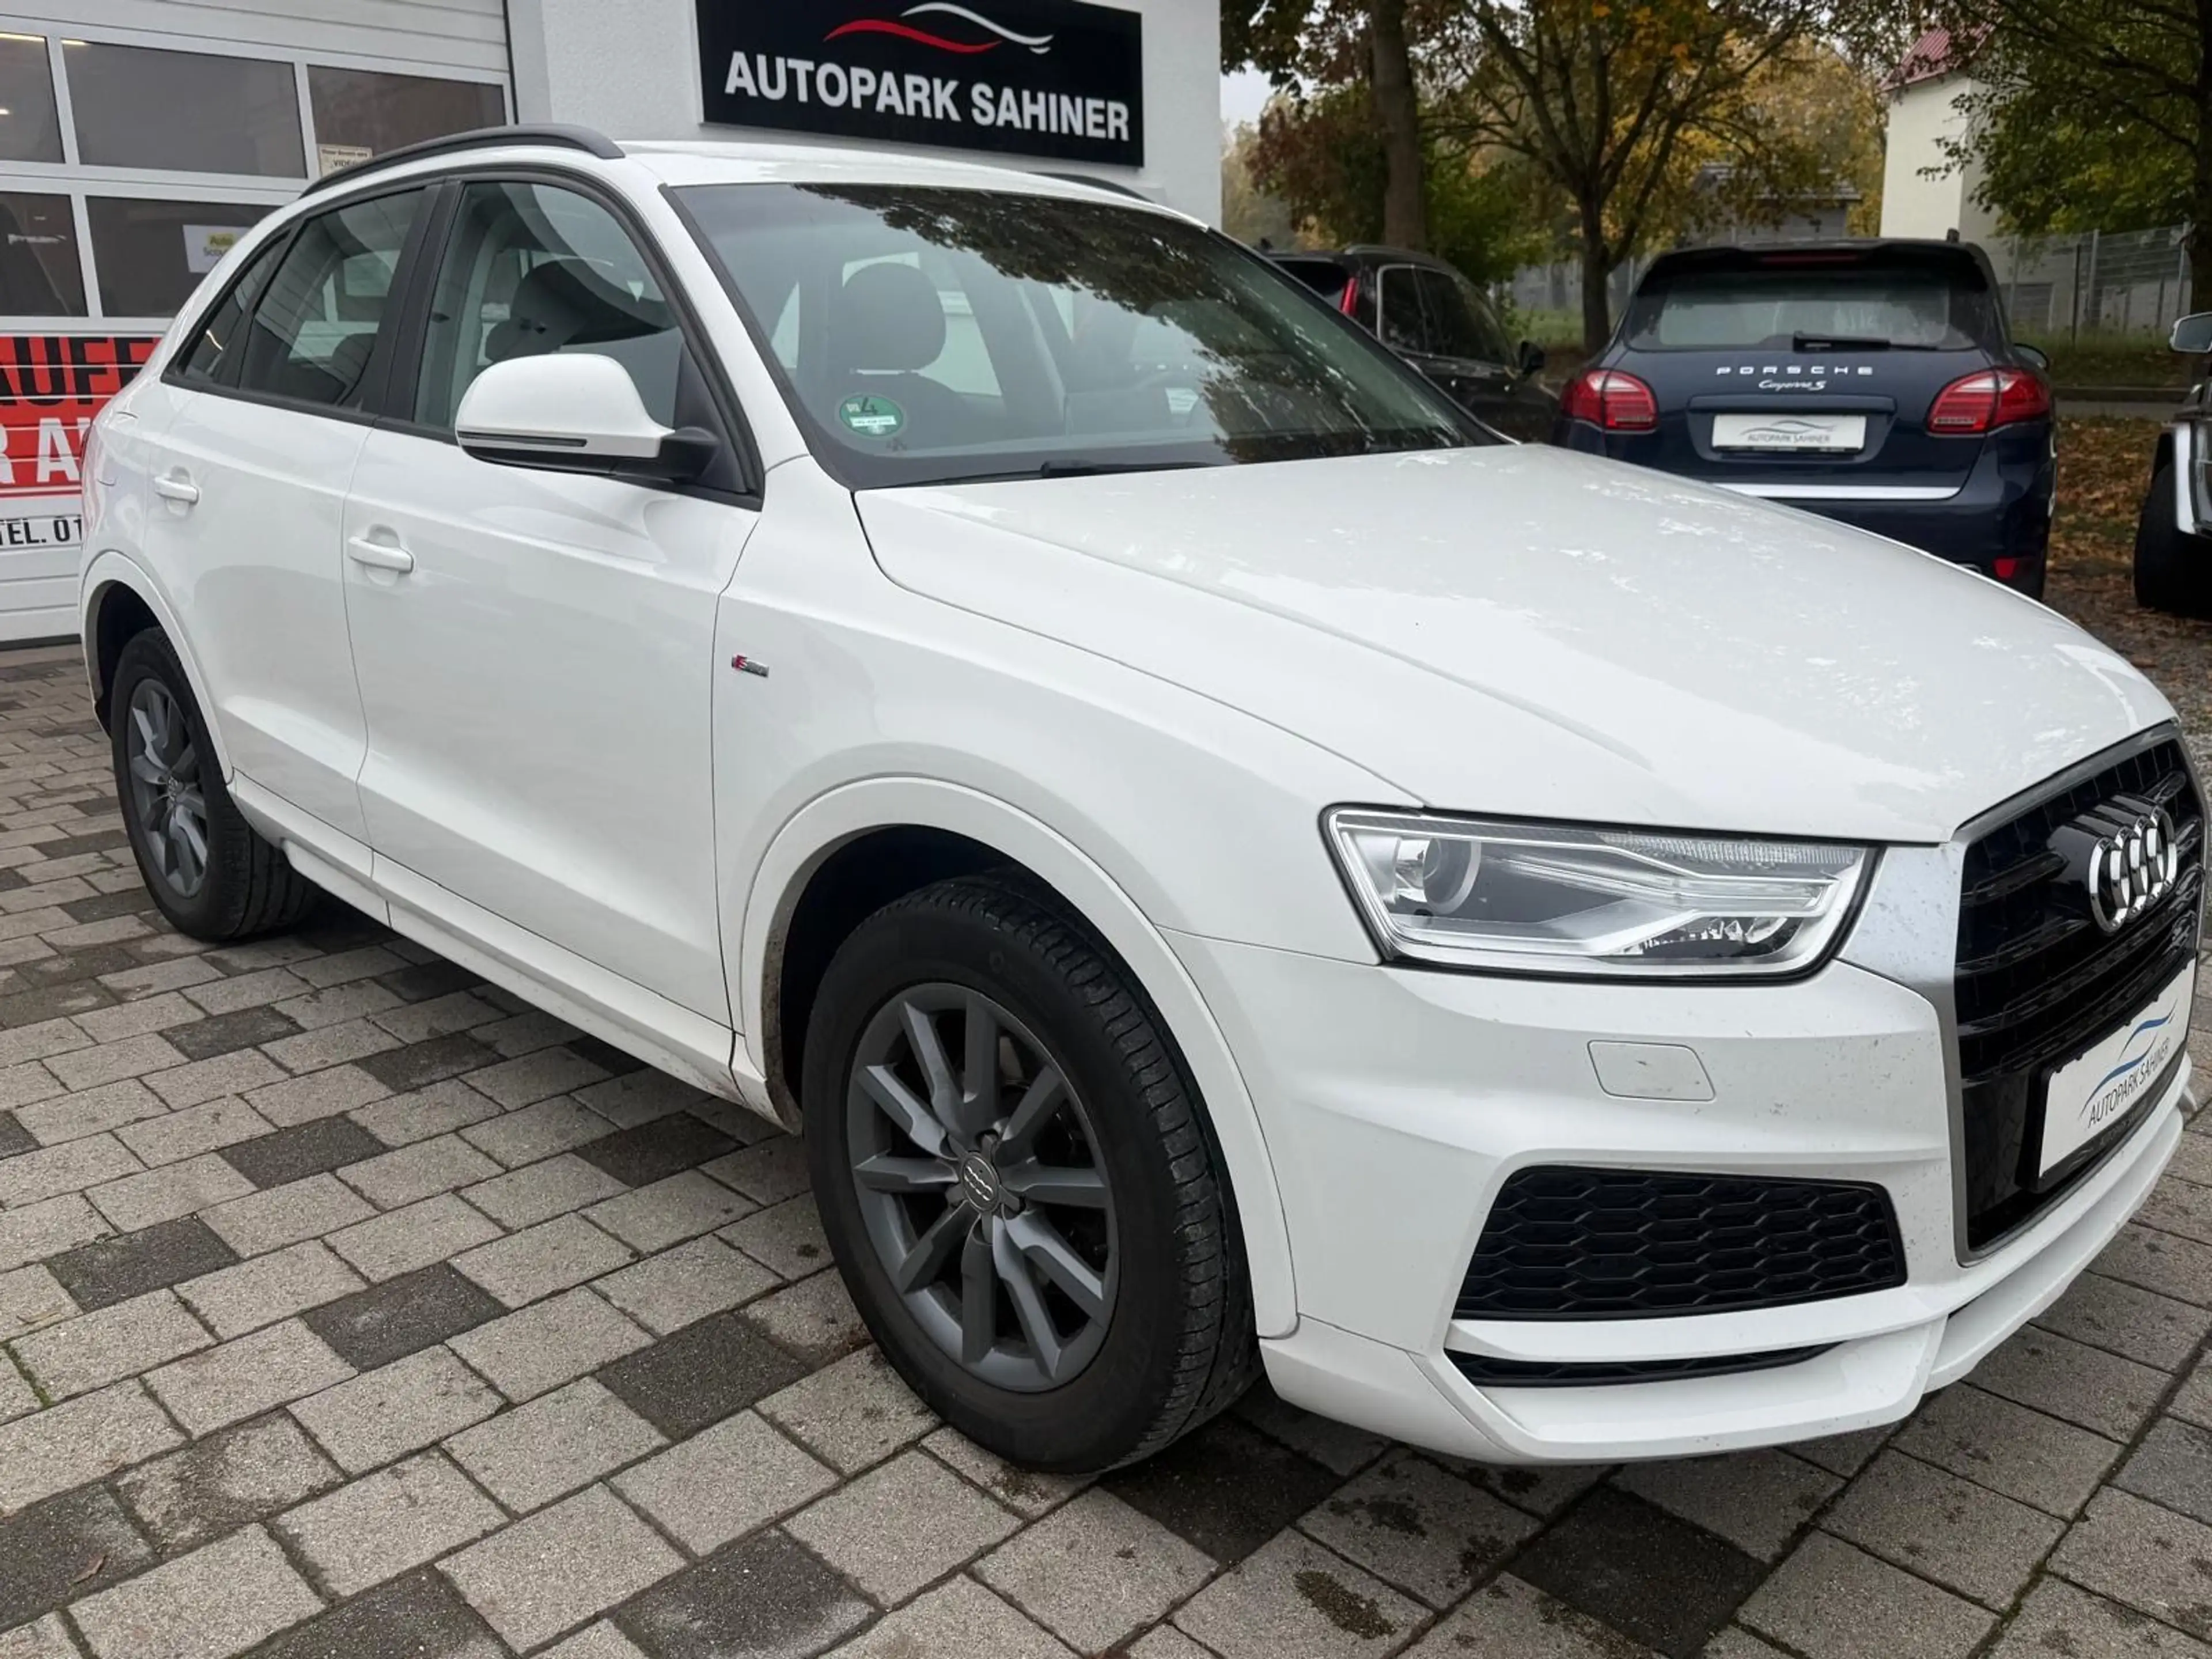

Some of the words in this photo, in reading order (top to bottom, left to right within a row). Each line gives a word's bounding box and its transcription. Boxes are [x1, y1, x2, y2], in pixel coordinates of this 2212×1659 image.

[724, 51, 961, 122] AUTOPARK
[971, 82, 1130, 141] SAHINER
[1717, 366, 1873, 374] PORSCHE
[2088, 1068, 2139, 1128] AUTOPARK
